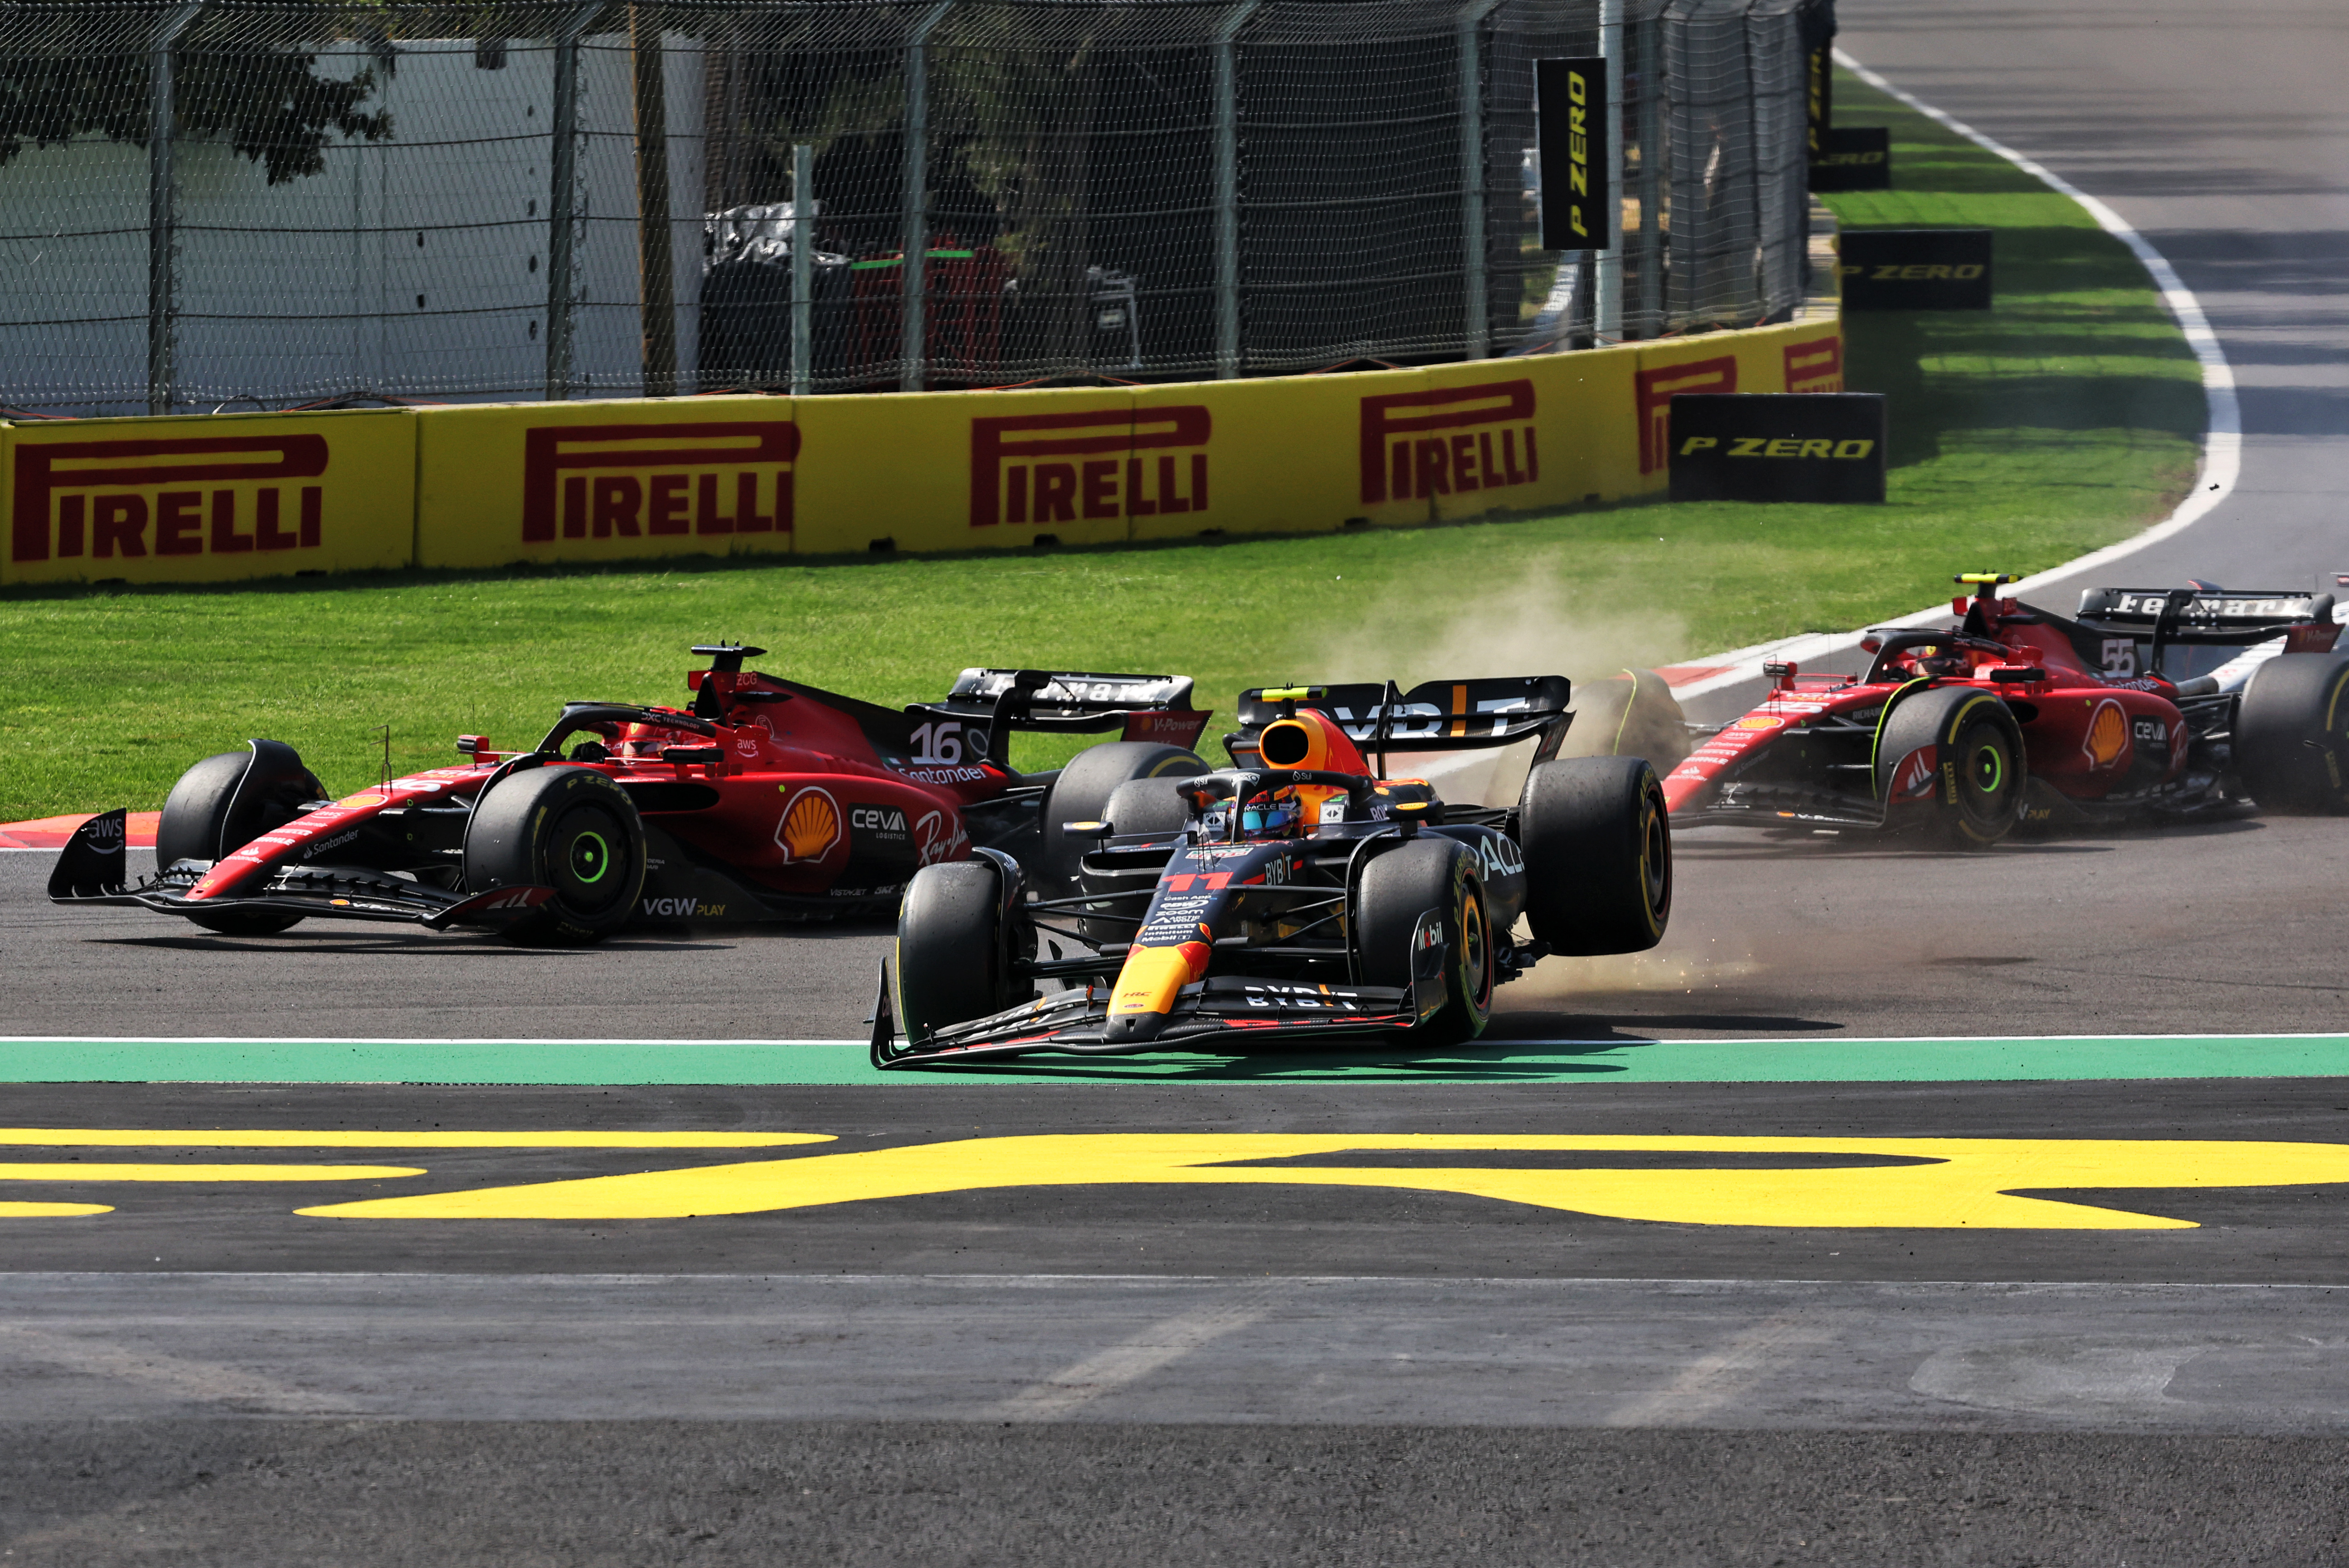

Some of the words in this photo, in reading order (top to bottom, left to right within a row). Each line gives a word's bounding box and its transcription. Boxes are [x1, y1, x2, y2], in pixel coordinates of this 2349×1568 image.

[1568, 71, 1587, 198] ZERO
[1569, 204, 1588, 237] P
[1870, 264, 1984, 280] ZERO
[1360, 378, 1539, 503] PIRELLI
[1679, 436, 1718, 456] P
[1727, 438, 1875, 459] ZERO
[970, 405, 1212, 527] PIRELLI
[522, 420, 801, 543] PIRELLI
[12, 434, 329, 562] PIRELLI
[2102, 638, 2135, 678] 55
[736, 673, 757, 686] ZCG
[1296, 685, 1525, 739] YBIT
[1752, 701, 1831, 714] 55
[641, 711, 661, 723] DXC
[663, 717, 700, 729] TECHNOLOGY
[1154, 718, 1201, 732] V-Power
[737, 738, 757, 750] aws
[910, 722, 962, 765] 16
[371, 778, 454, 792] 16
[567, 778, 578, 789] P
[584, 775, 632, 805] ZERO
[1244, 803, 1277, 812] RACLE
[88, 817, 123, 839] aws
[852, 808, 905, 831] CEVA
[314, 829, 359, 855] Santander
[876, 832, 905, 840] LOGISTICS
[1265, 851, 1292, 886] BYBIT
[1453, 851, 1466, 903] ZERO
[874, 885, 897, 895] SKF
[1161, 872, 1234, 892] 11
[643, 898, 697, 916] VGW
[697, 905, 726, 916] PLAY
[1418, 921, 1443, 951] Mobil
